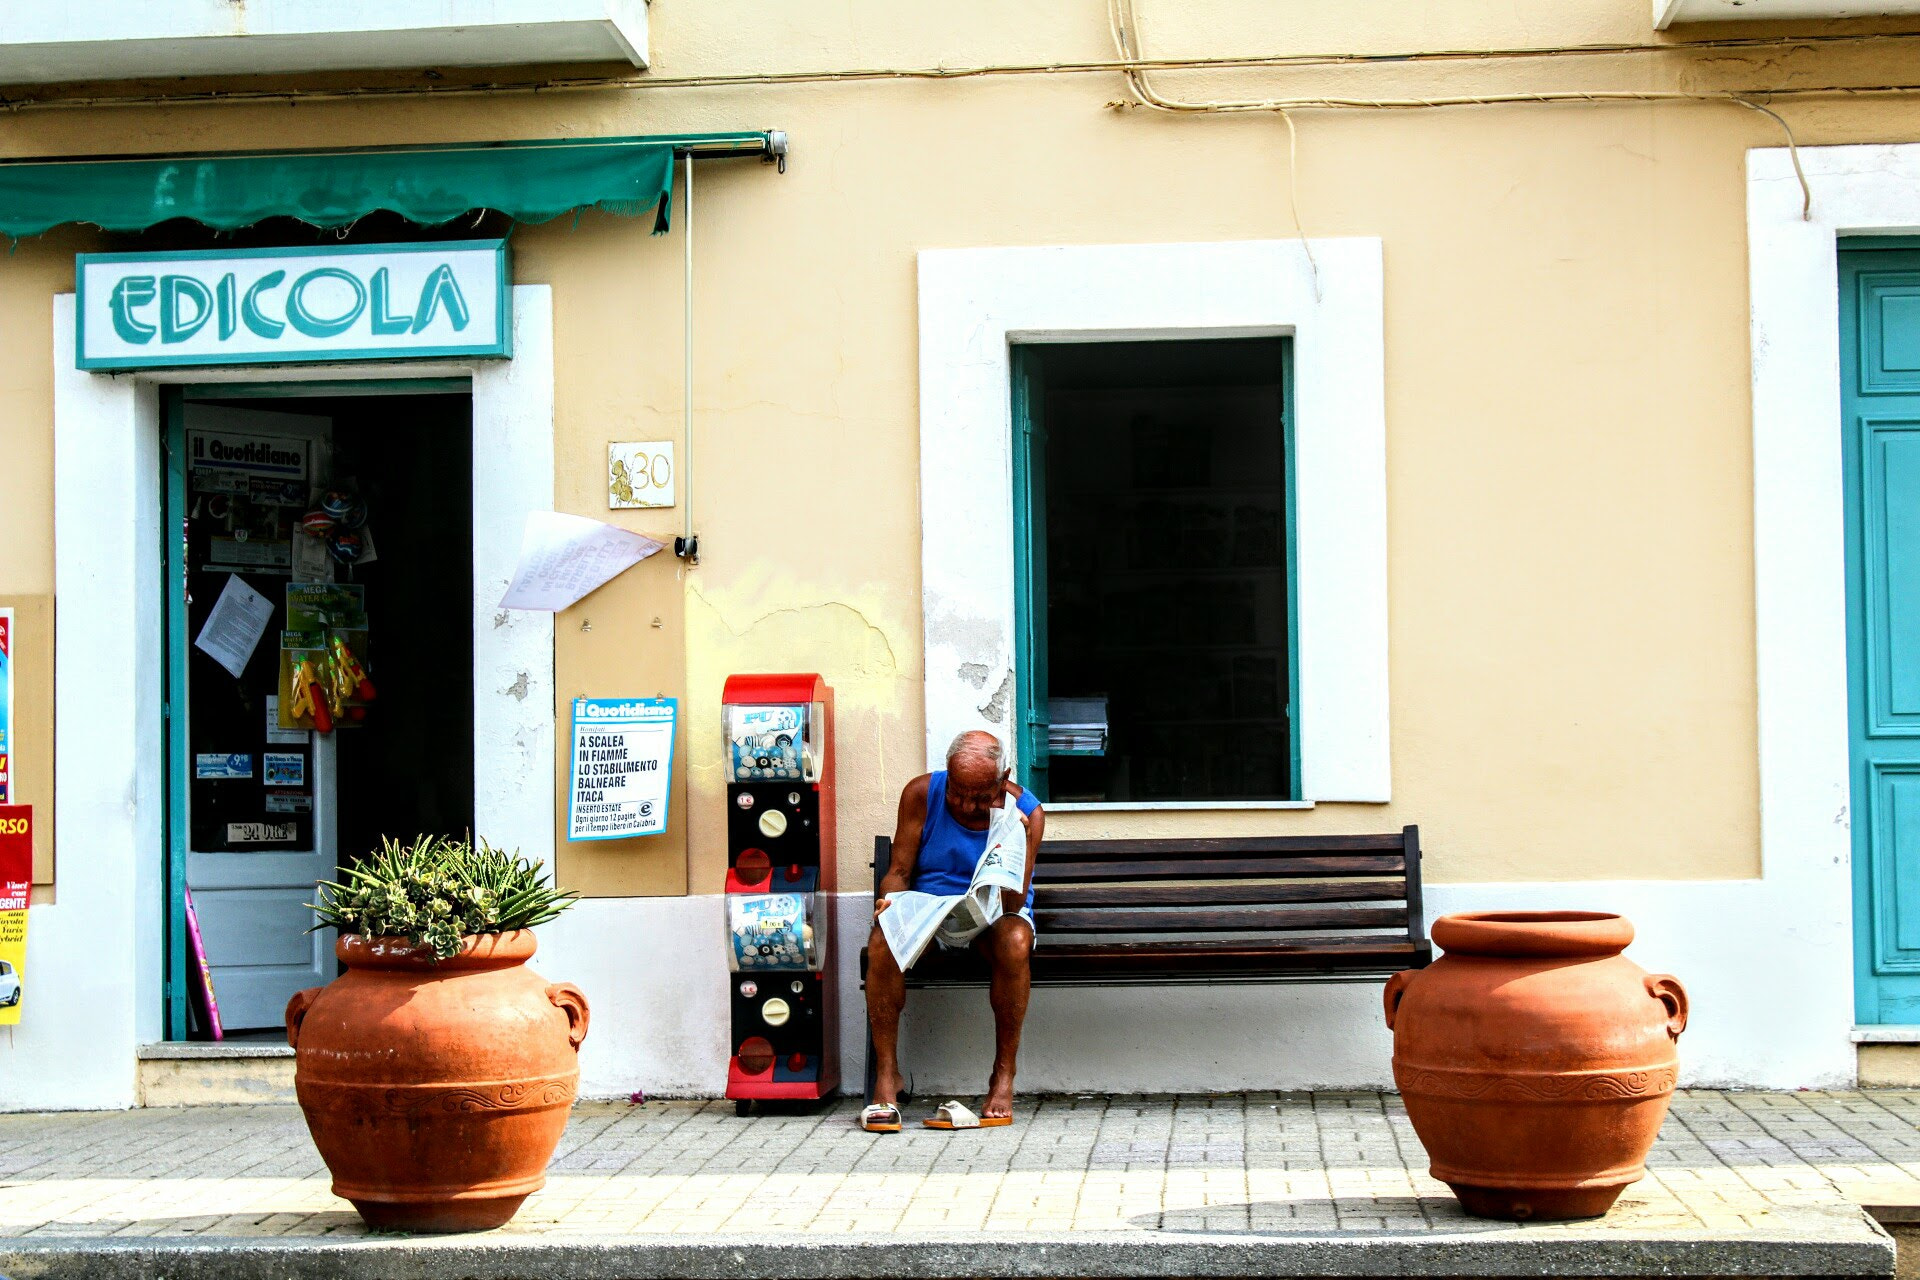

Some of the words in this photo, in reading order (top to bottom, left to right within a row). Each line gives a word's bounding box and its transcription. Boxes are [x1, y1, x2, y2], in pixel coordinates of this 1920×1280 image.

[109, 264, 470, 345] EDICOLA
[193, 436, 204, 457] il
[210, 439, 301, 466] Quotidiano
[634, 452, 671, 489] 30
[575, 703, 586, 717] il
[586, 702, 674, 717] Quotidiano
[579, 736, 586, 748] A
[588, 735, 624, 748] SCALEA
[579, 750, 589, 762] IN
[591, 748, 628, 762] FIAMME
[578, 762, 590, 775] LO
[592, 760, 658, 775] STABILIMENTO
[578, 776, 626, 789] BALNEARE
[577, 791, 604, 803] ITACA
[576, 804, 601, 814] INSERTO
[601, 803, 622, 813] ESTATE
[575, 815, 589, 825] Ogni
[589, 814, 609, 825] giorno
[610, 813, 617, 821] 12
[617, 812, 636, 823] pagine
[575, 825, 584, 834] per
[590, 823, 609, 833] tempo
[609, 821, 626, 831] libero
[0, 898, 26, 909] GENTE
